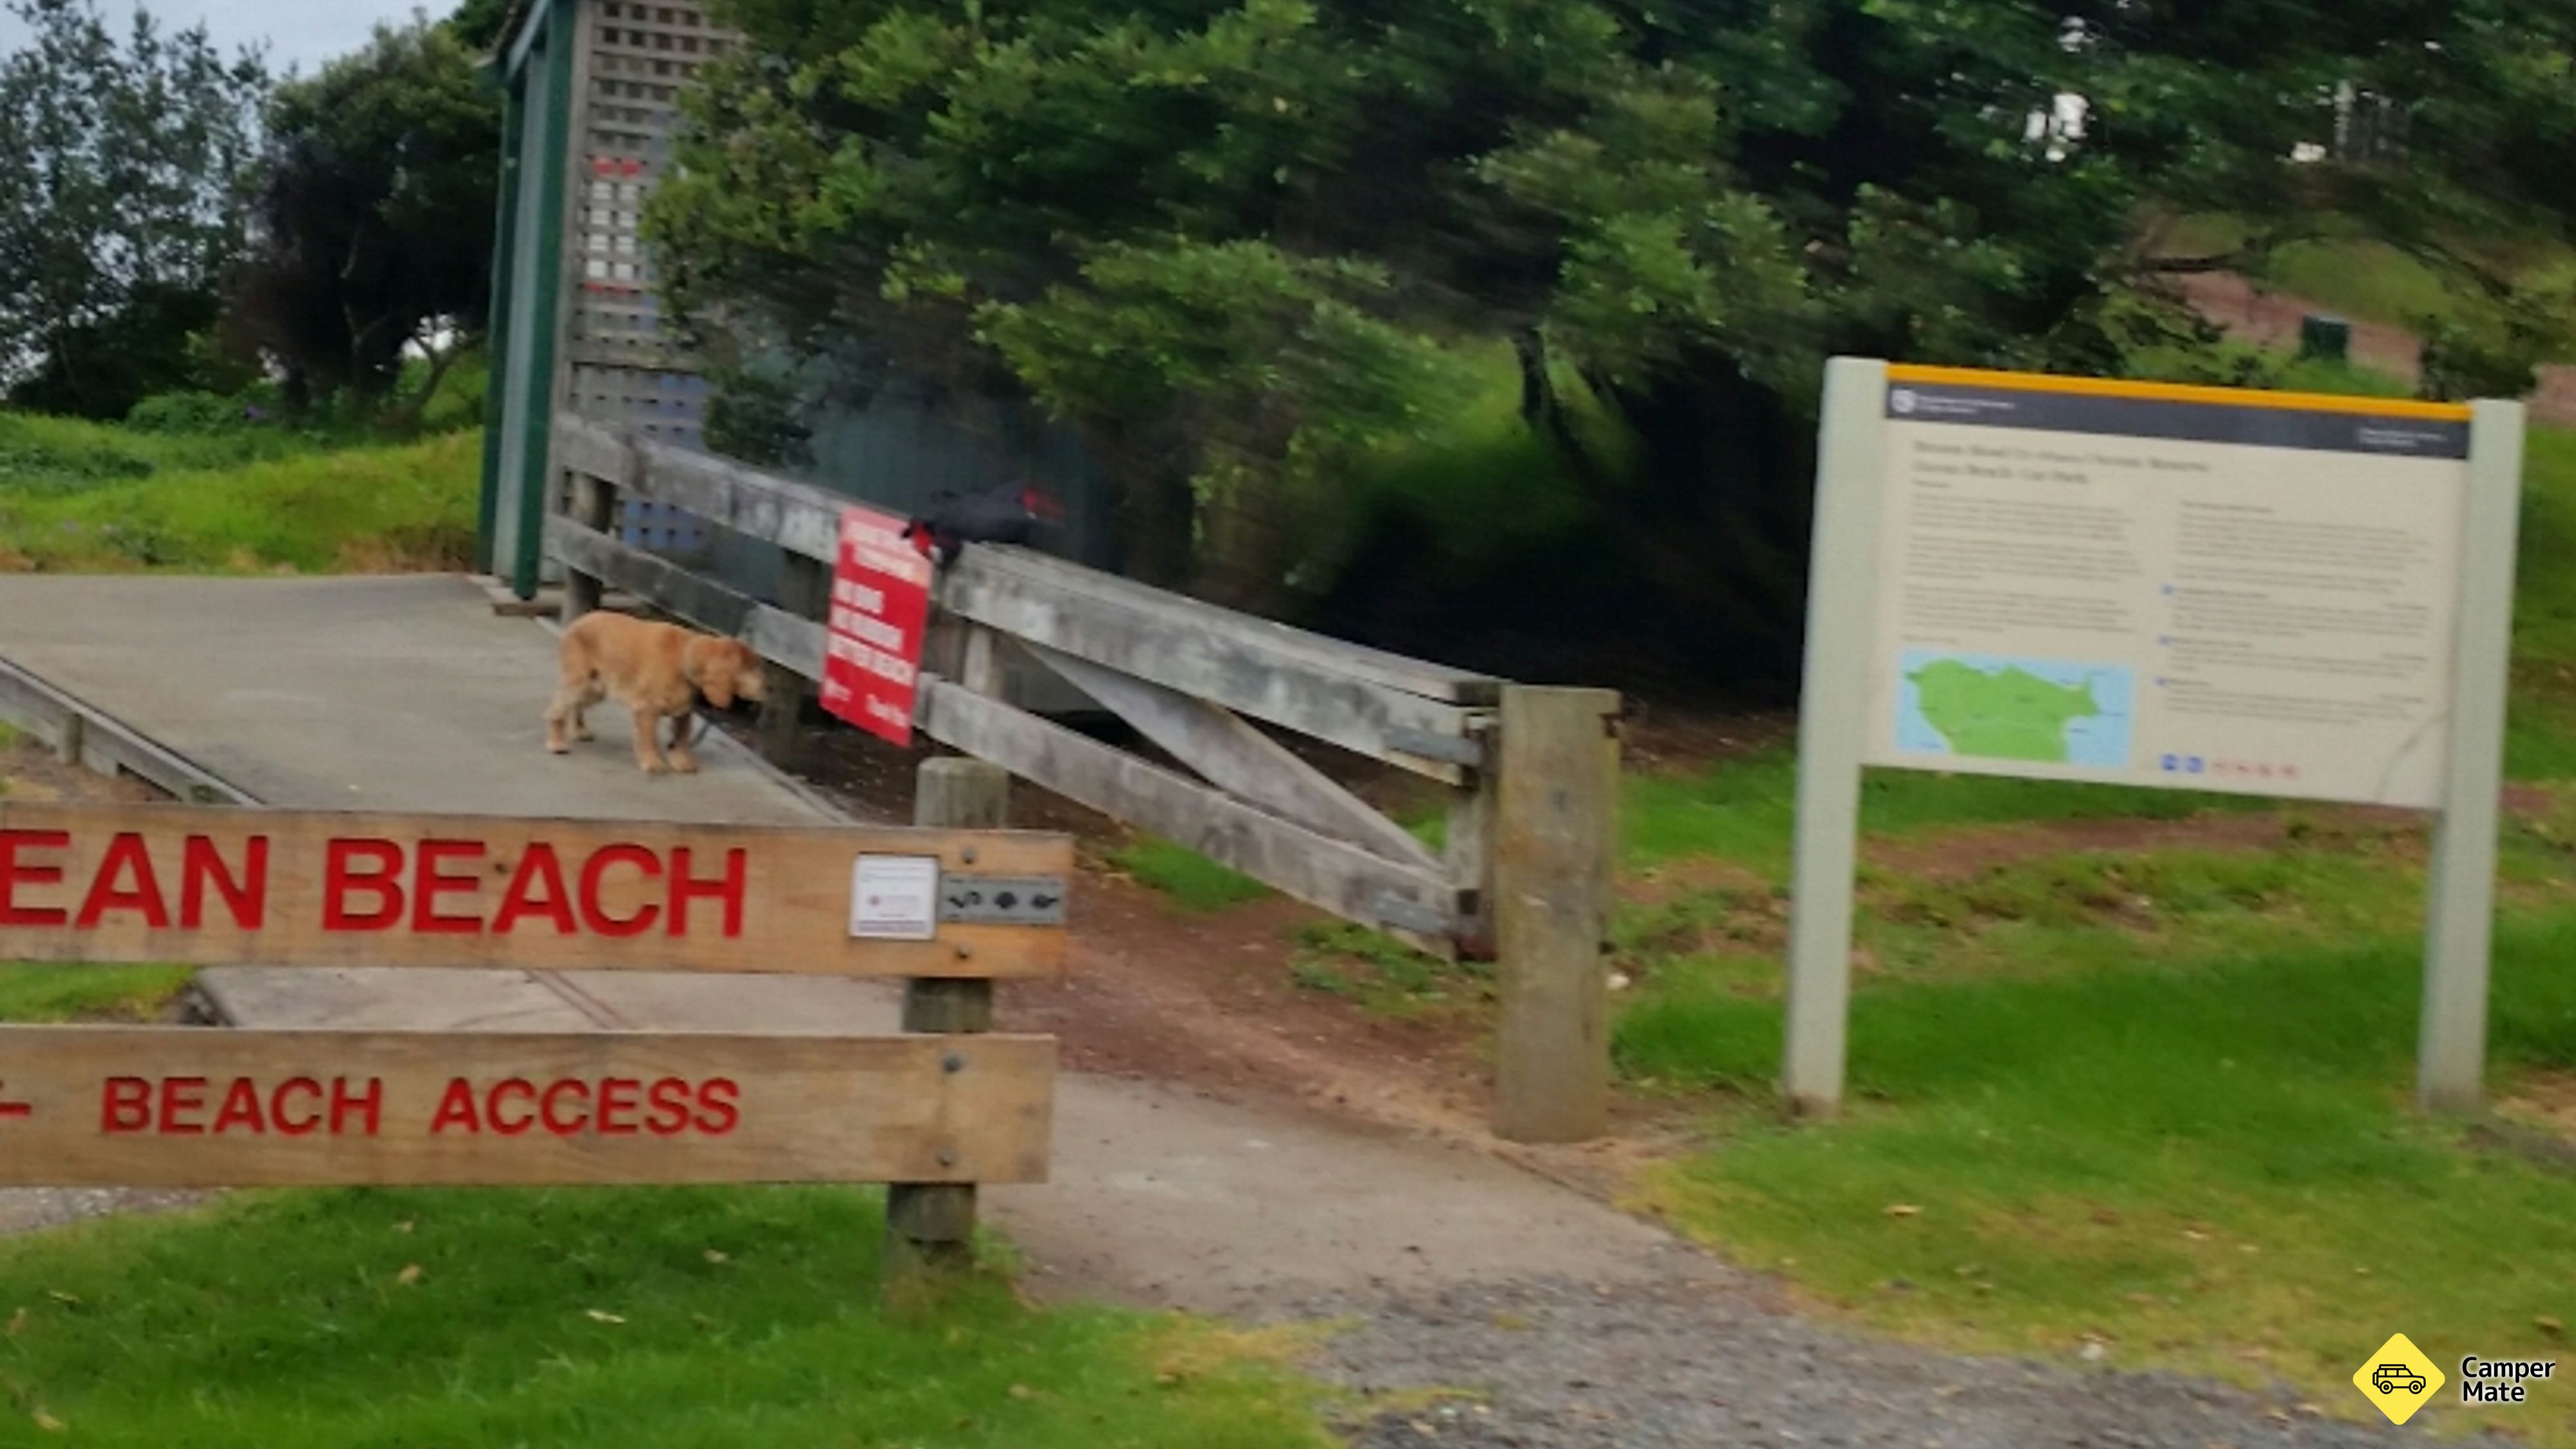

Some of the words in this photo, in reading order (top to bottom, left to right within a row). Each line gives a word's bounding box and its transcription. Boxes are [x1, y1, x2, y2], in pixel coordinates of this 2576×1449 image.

[321, 837, 747, 939] BEACH
[100, 1077, 382, 1137] BEACH
[430, 1077, 740, 1137] ACCESS
